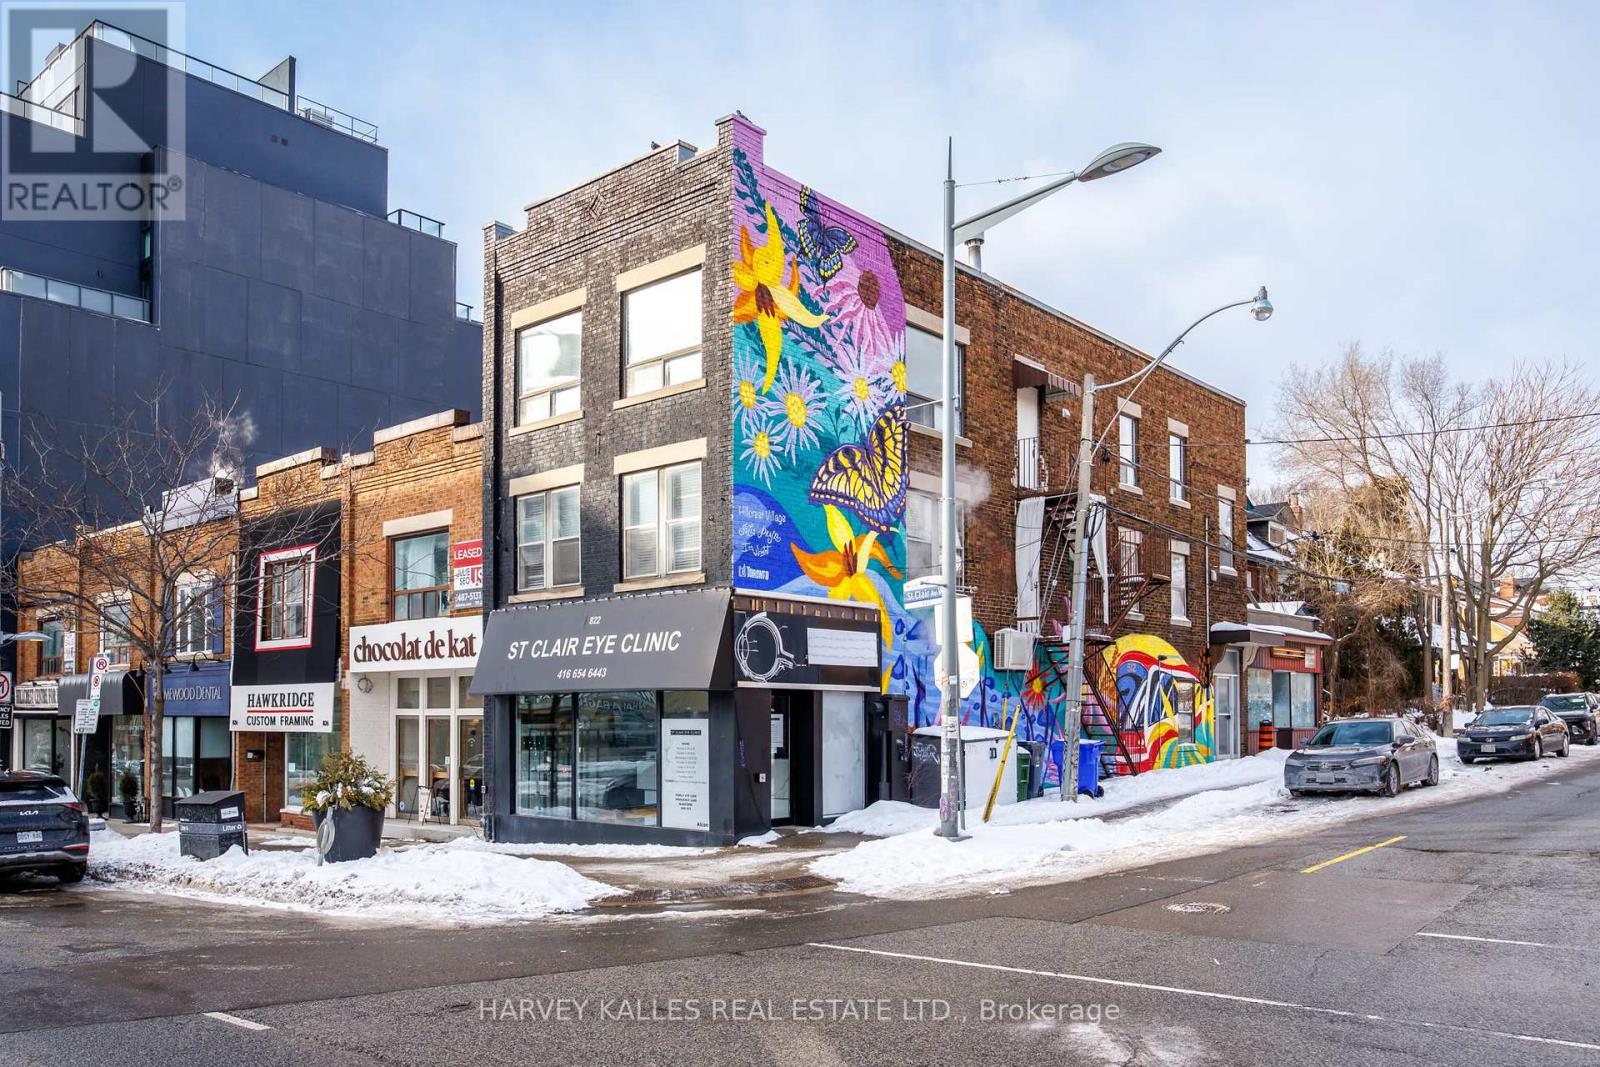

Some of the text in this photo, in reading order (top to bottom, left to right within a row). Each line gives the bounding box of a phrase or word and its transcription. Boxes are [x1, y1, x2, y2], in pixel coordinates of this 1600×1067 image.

[765, 510, 786, 525] Village
[455, 547, 482, 560] LEASED
[915, 589, 929, 600] Clair
[589, 616, 601, 624] 822
[353, 629, 476, 663] chocolat de kat
[507, 630, 682, 659] ST CLAIR EYE CLINIC
[557, 667, 607, 679] 416 654 6443
[196, 686, 223, 699] DENTAL
[247, 692, 315, 708] HAWKRIDGE
[246, 715, 276, 726] CUSTOM
[280, 715, 314, 726] FRAMING
